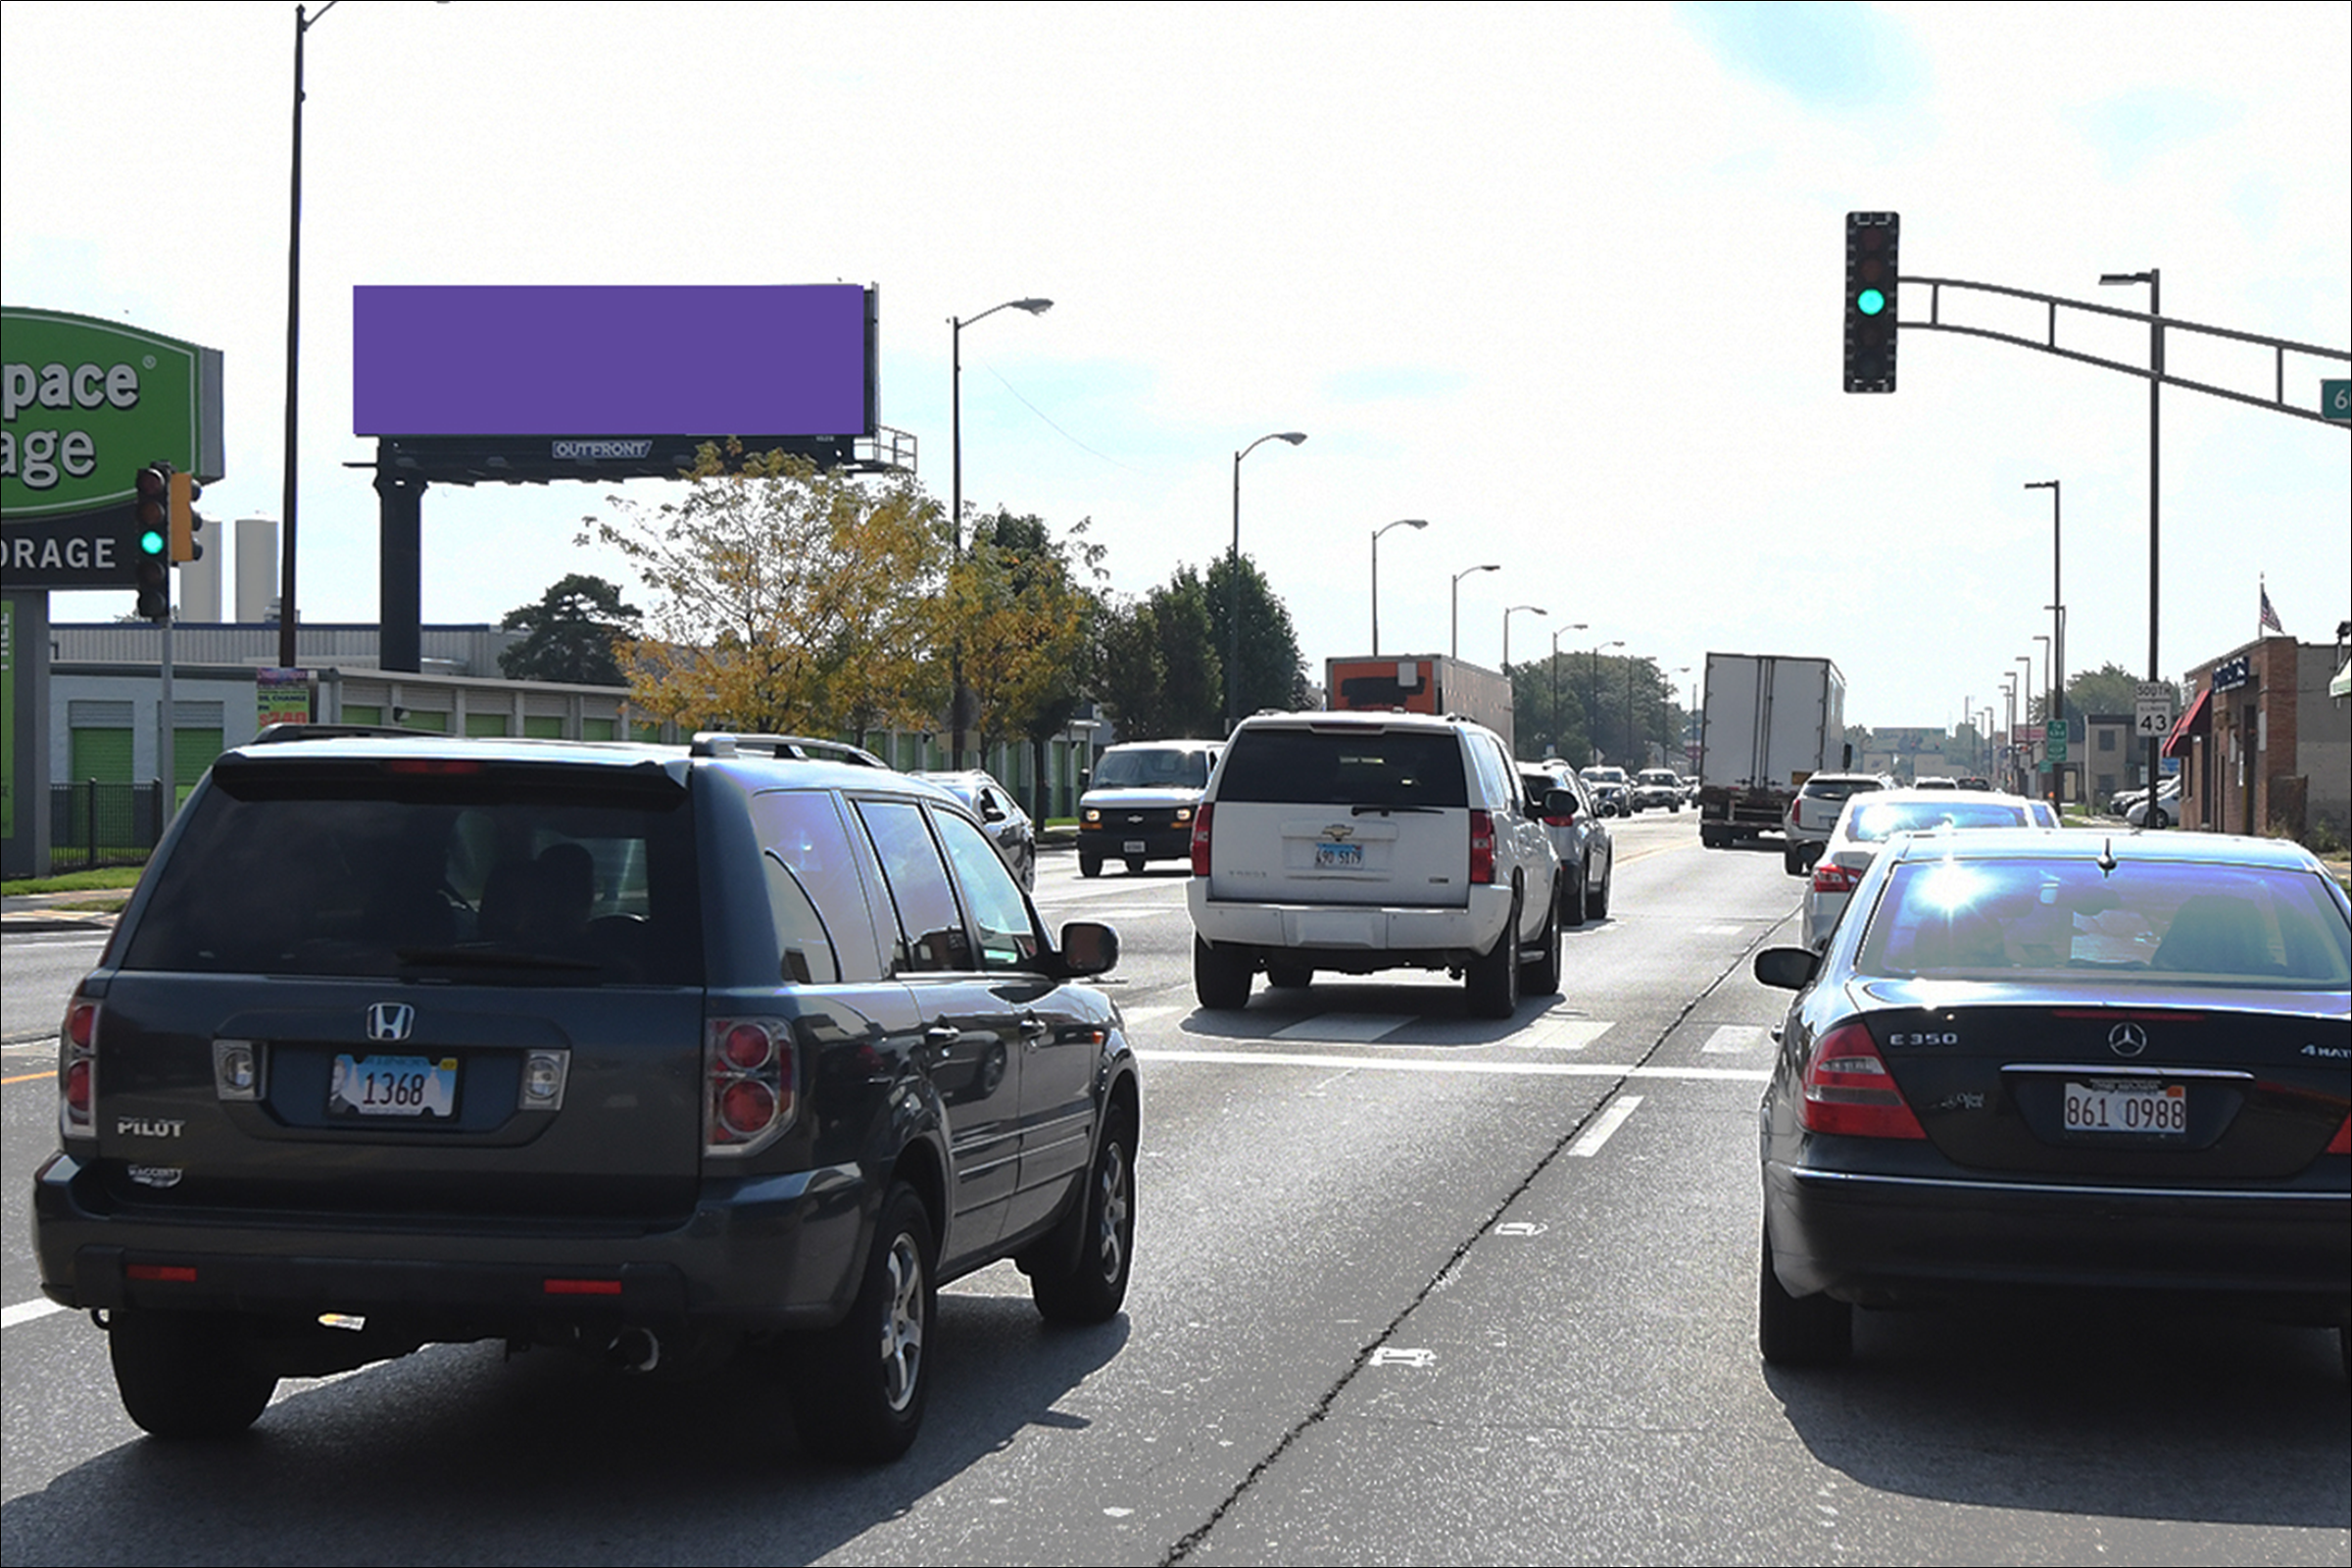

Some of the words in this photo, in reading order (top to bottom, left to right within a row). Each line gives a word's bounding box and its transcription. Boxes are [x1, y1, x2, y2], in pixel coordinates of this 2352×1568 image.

[3, 363, 139, 420] pace
[2334, 389, 2351, 410] 6
[556, 442, 647, 457] OUTFRONT
[2137, 685, 2171, 697] SOUTH
[2140, 714, 2167, 731] 43
[1889, 1033, 1904, 1046] E
[1910, 1032, 1958, 1046] 350
[363, 1072, 425, 1105] 1368
[2067, 1096, 2109, 1127] 861
[2126, 1098, 2184, 1129] 0988
[118, 1116, 185, 1137] PILOT
